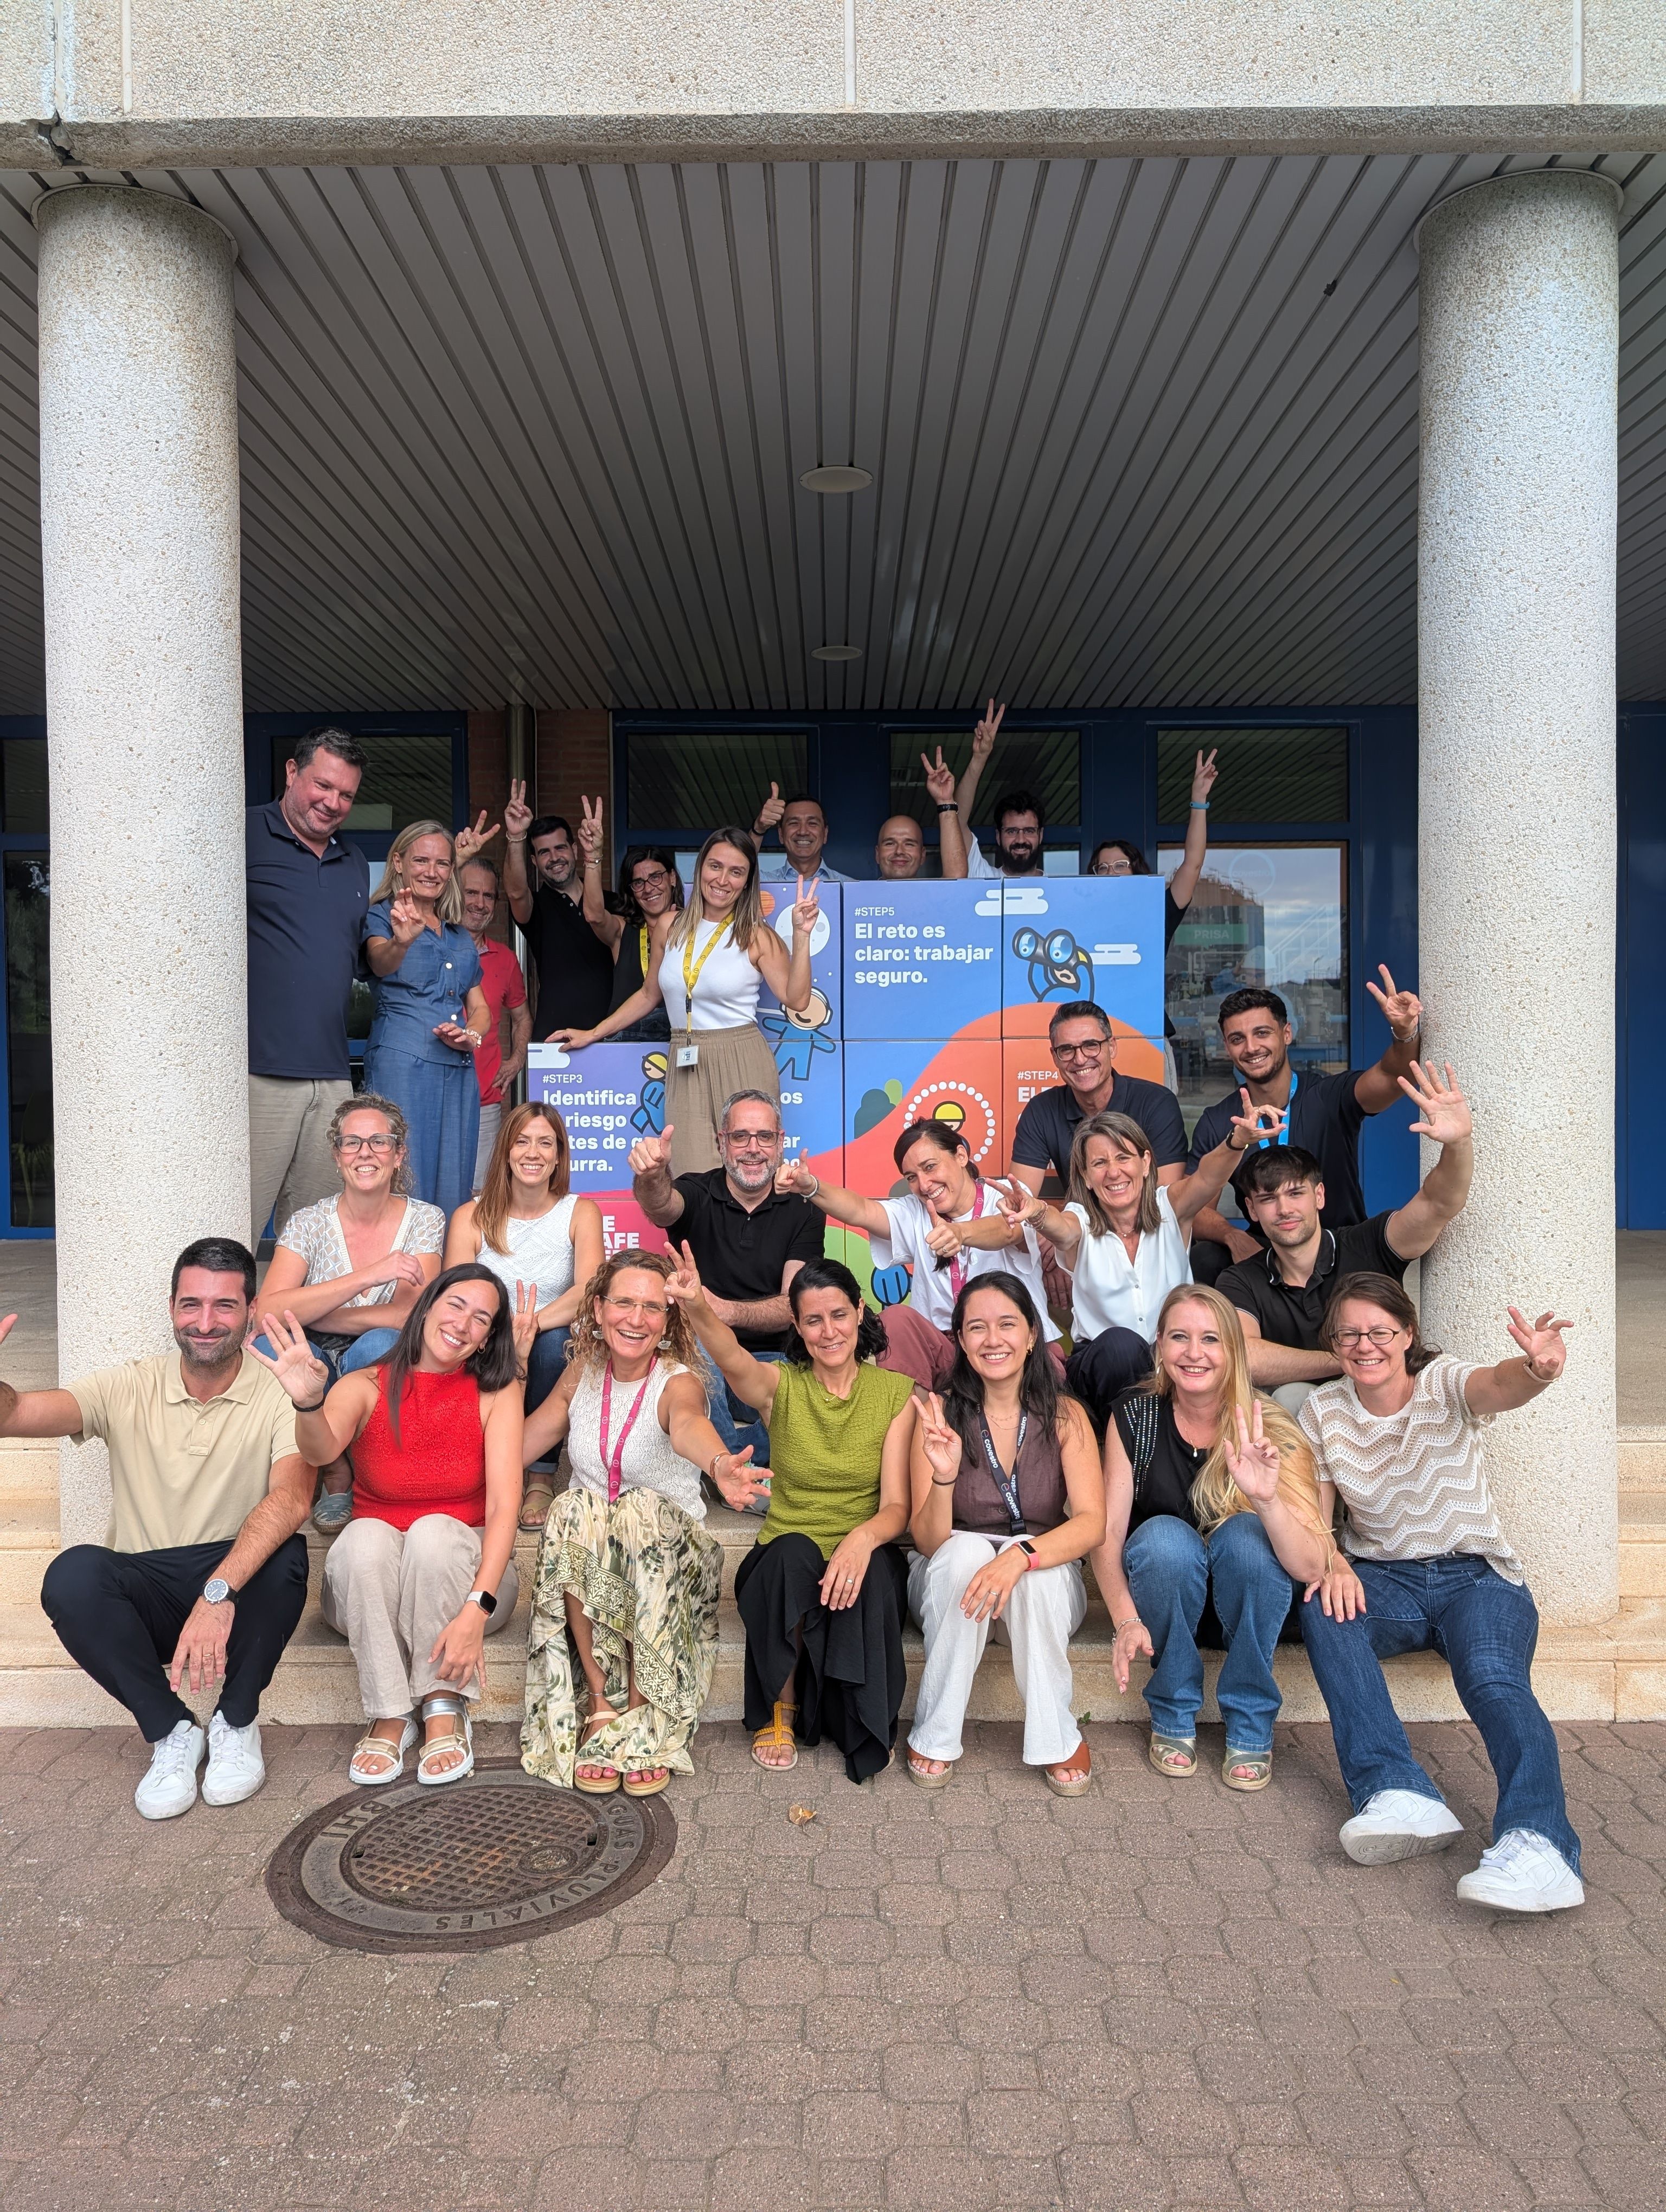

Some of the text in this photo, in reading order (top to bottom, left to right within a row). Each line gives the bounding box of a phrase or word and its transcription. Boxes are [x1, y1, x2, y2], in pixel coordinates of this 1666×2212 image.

[855, 907, 895, 916] #STEP5
[855, 923, 945, 938] El reto es
[1194, 929, 1229, 939] PRISA
[855, 944, 994, 964] claro: trabajar
[855, 971, 928, 987] seguro.
[543, 1074, 582, 1084] #STEP3
[1017, 1071, 1059, 1080] #STEP4
[543, 1090, 636, 1105] Identifica
[566, 1112, 626, 1131] riesgo
[568, 1135, 598, 1149] tes
[603, 1134, 626, 1149] de
[570, 1159, 613, 1172] urra.
[603, 1216, 616, 1232] E
[603, 1232, 639, 1249] AFE
[1017, 1416, 1027, 1446] covestro
[984, 1439, 998, 1468] covestro
[1005, 1492, 1021, 1520] covestro
[435, 1796, 637, 1930] AGUAS PLUVIALES
